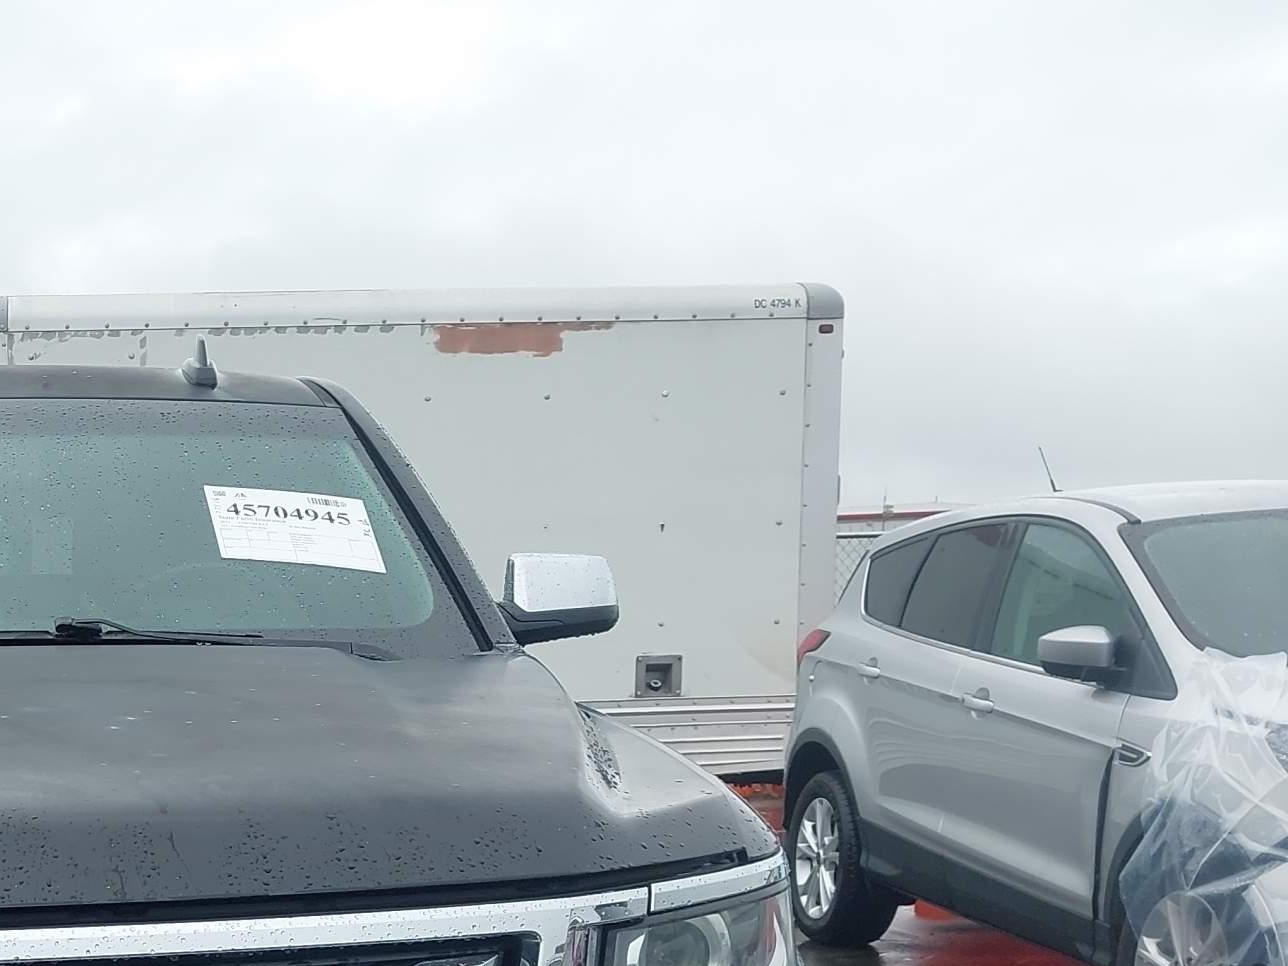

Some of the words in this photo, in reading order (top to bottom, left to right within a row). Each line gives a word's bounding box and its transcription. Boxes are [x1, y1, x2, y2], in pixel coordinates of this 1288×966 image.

[754, 299, 767, 308] DC
[770, 298, 792, 308] 4794
[794, 298, 801, 308] K
[226, 502, 351, 526] 45704945
